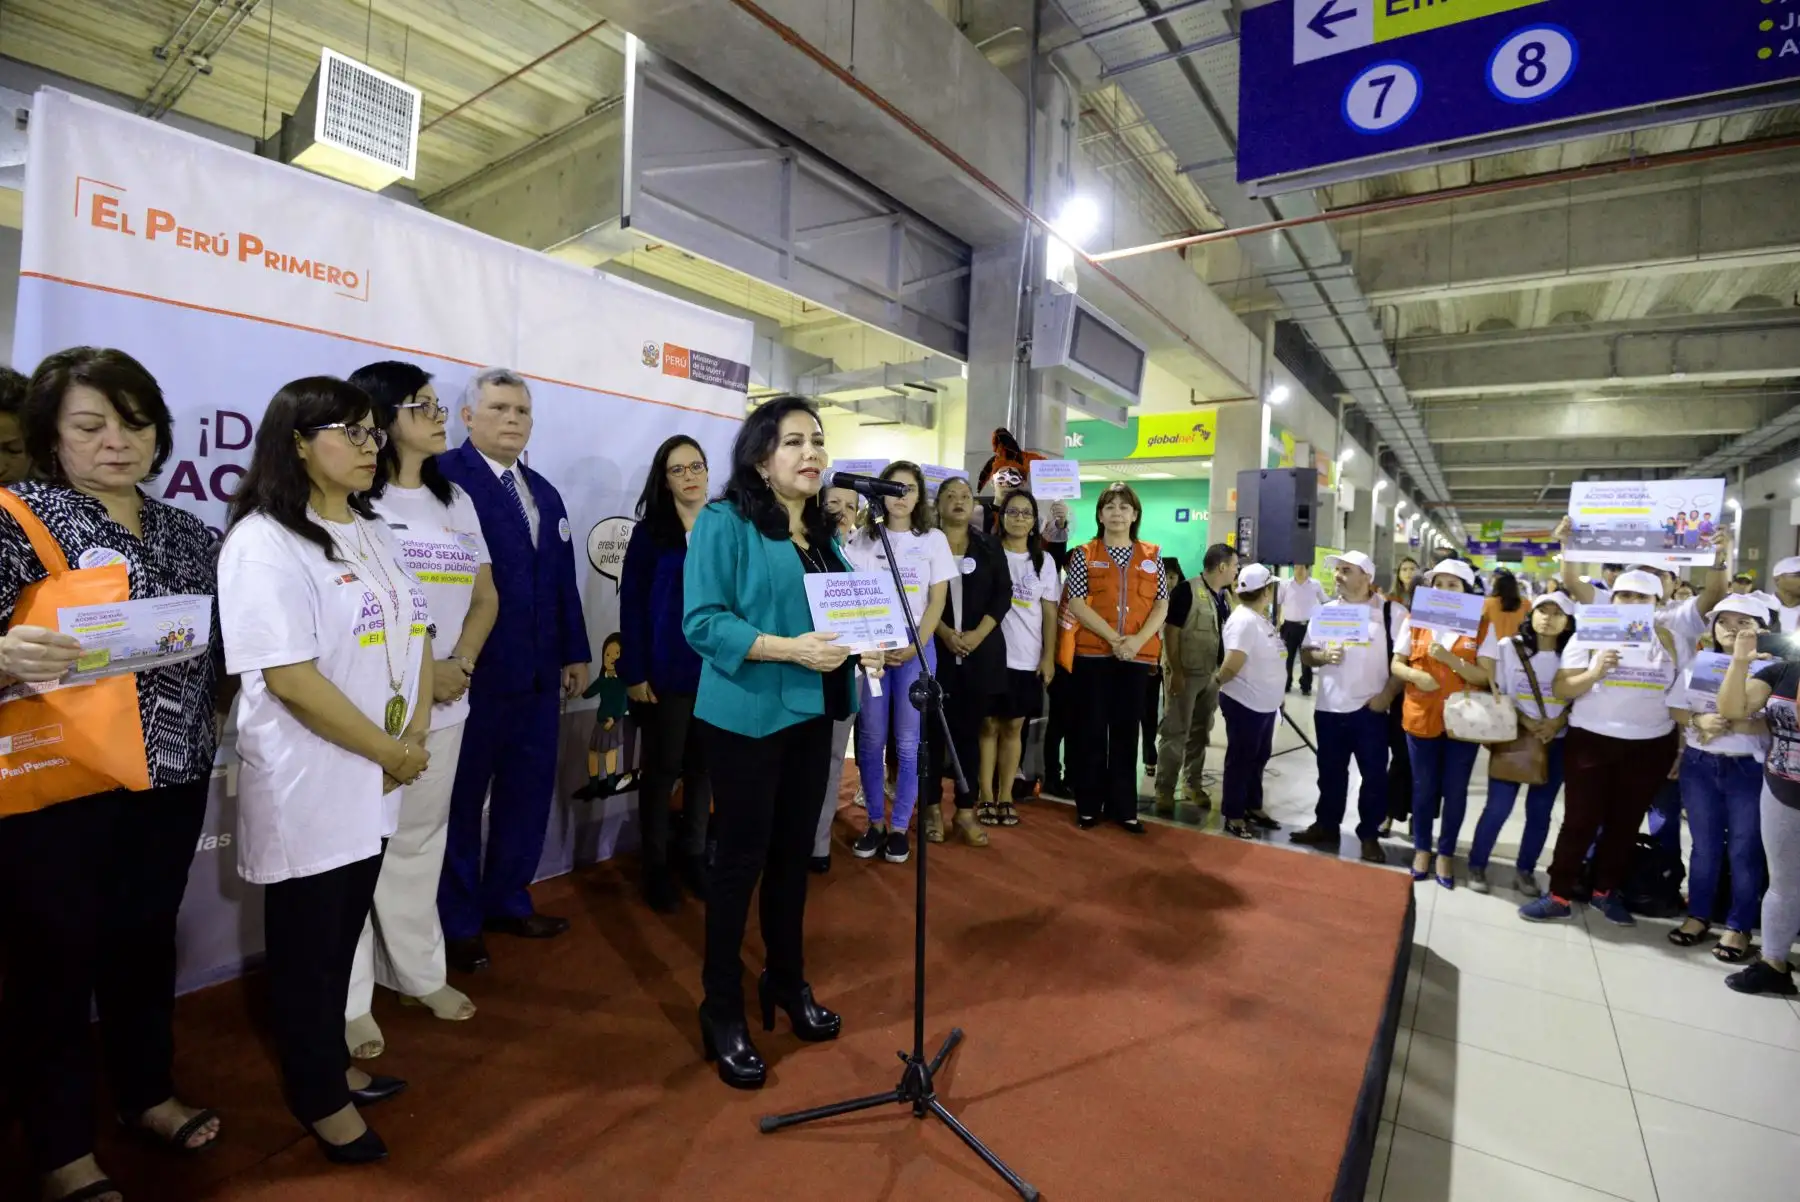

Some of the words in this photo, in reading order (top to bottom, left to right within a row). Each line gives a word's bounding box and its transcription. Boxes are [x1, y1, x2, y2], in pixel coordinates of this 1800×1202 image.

[1368, 74, 1396, 119] 7
[1515, 41, 1547, 88] 8
[665, 354, 687, 369] PERÚ
[1147, 433, 1196, 447] globalnet
[597, 540, 615, 550] eres
[600, 552, 620, 566] pide
[824, 588, 852, 598] ACOSO
[853, 586, 884, 596] SEXUAL
